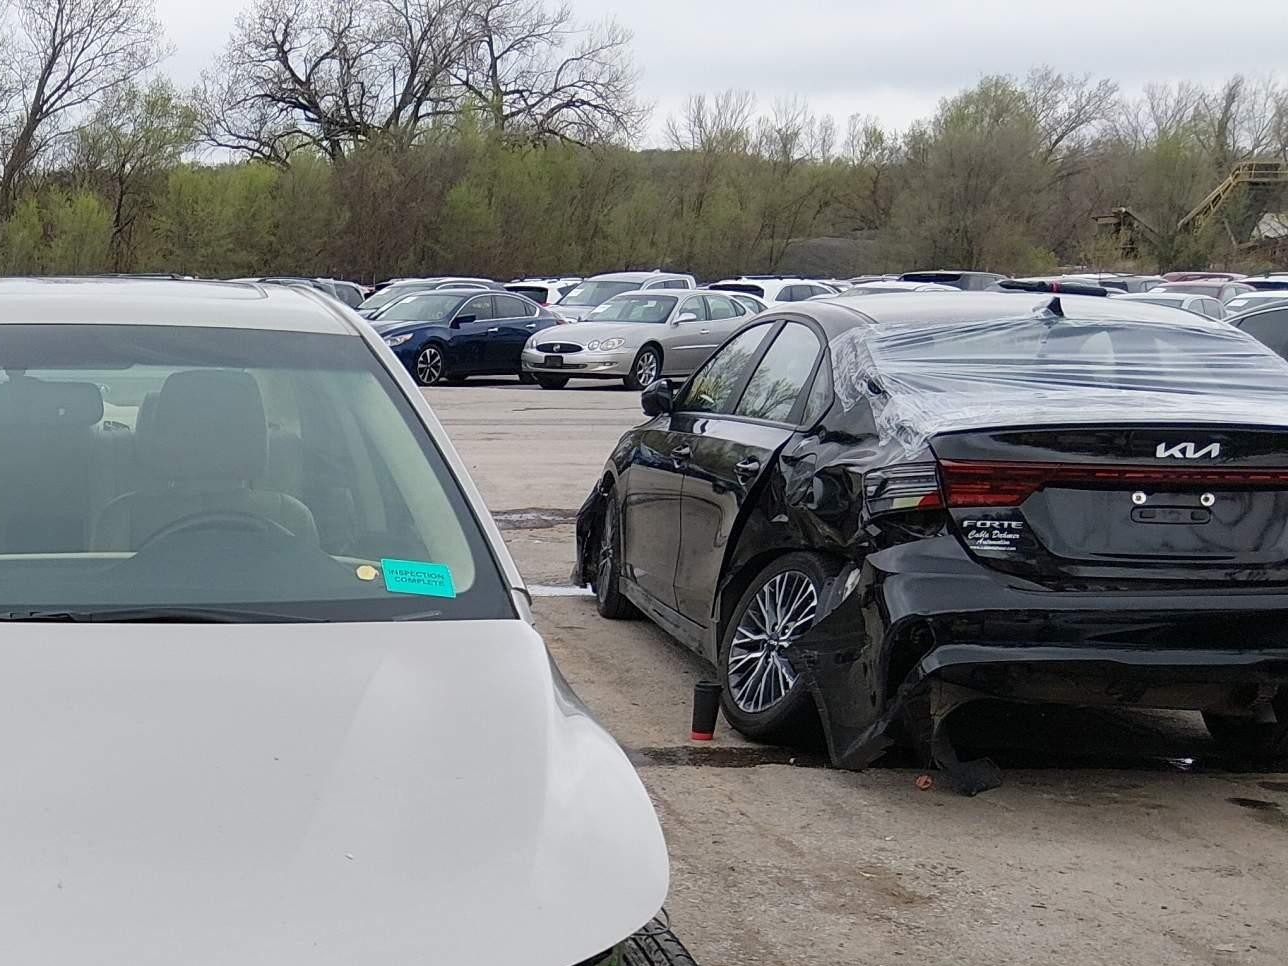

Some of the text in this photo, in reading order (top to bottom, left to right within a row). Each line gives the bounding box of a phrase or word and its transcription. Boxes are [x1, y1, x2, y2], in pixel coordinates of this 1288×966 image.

[1155, 442, 1221, 458] KIA
[962, 520, 1024, 529] FORTE
[388, 568, 445, 580] INSPECTION
[394, 576, 445, 587] COMPLETE
